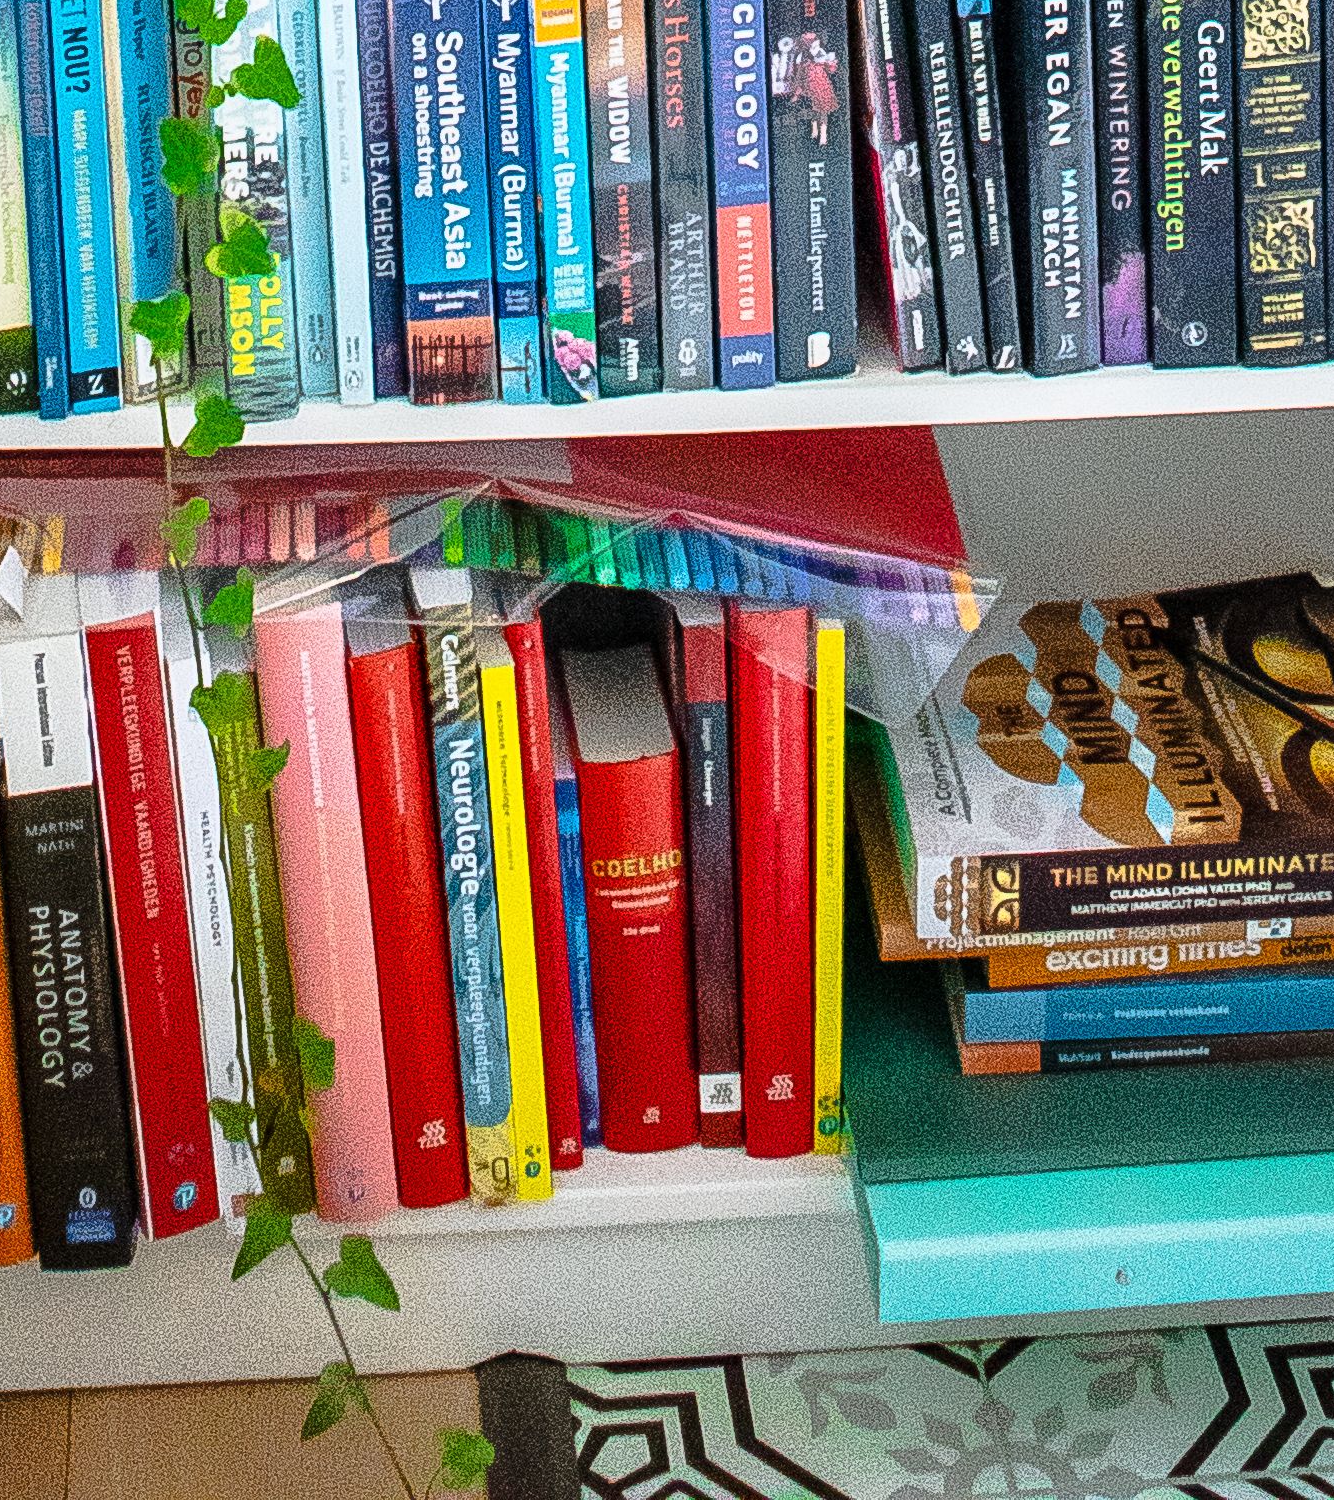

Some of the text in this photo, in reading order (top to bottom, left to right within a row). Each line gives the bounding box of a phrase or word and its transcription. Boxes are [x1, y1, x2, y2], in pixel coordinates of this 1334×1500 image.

[62, 26, 91, 95] NOU?
[175, 71, 205, 119] yes
[544, 52, 568, 157] Myanmar
[607, 35, 625, 69] THE
[664, 15, 691, 129] Horses
[1045, 52, 1072, 148] EGAN
[1197, 19, 1226, 175] Geert Mak
[366, 47, 396, 279] COELHO DE ALCHEMIST
[412, 32, 437, 198] on shoestring
[434, 29, 472, 269] Southeast Asia
[496, 31, 529, 271] Myanmar (Burma)
[607, 75, 632, 164] WIDOW
[928, 42, 966, 260] REBELLENDOCHTER
[1107, 42, 1133, 211] WINTERING
[1156, 40, 1193, 251] verwachtingen
[807, 161, 826, 193] Het
[667, 221, 689, 311] BRAND
[685, 210, 707, 316] ARTHUR
[736, 214, 756, 322] NETTLETON
[1042, 207, 1062, 288] BEACH
[1062, 167, 1082, 318] MANHATTAN
[440, 633, 485, 897] Gelmers Neurologie
[1053, 668, 1130, 765] MIND
[1116, 607, 1226, 826] ILLUMINATED
[114, 644, 161, 920] VERPLEEGKUNDIGE VAARDIGHEDEN
[592, 848, 683, 878] COELHO
[1050, 865, 1099, 887] THE
[1106, 862, 1173, 884] MIND
[1070, 902, 1128, 915] MATTHEW
[27, 905, 66, 1090] PHYSIOLOGY
[56, 907, 92, 1052] ANATOMY
